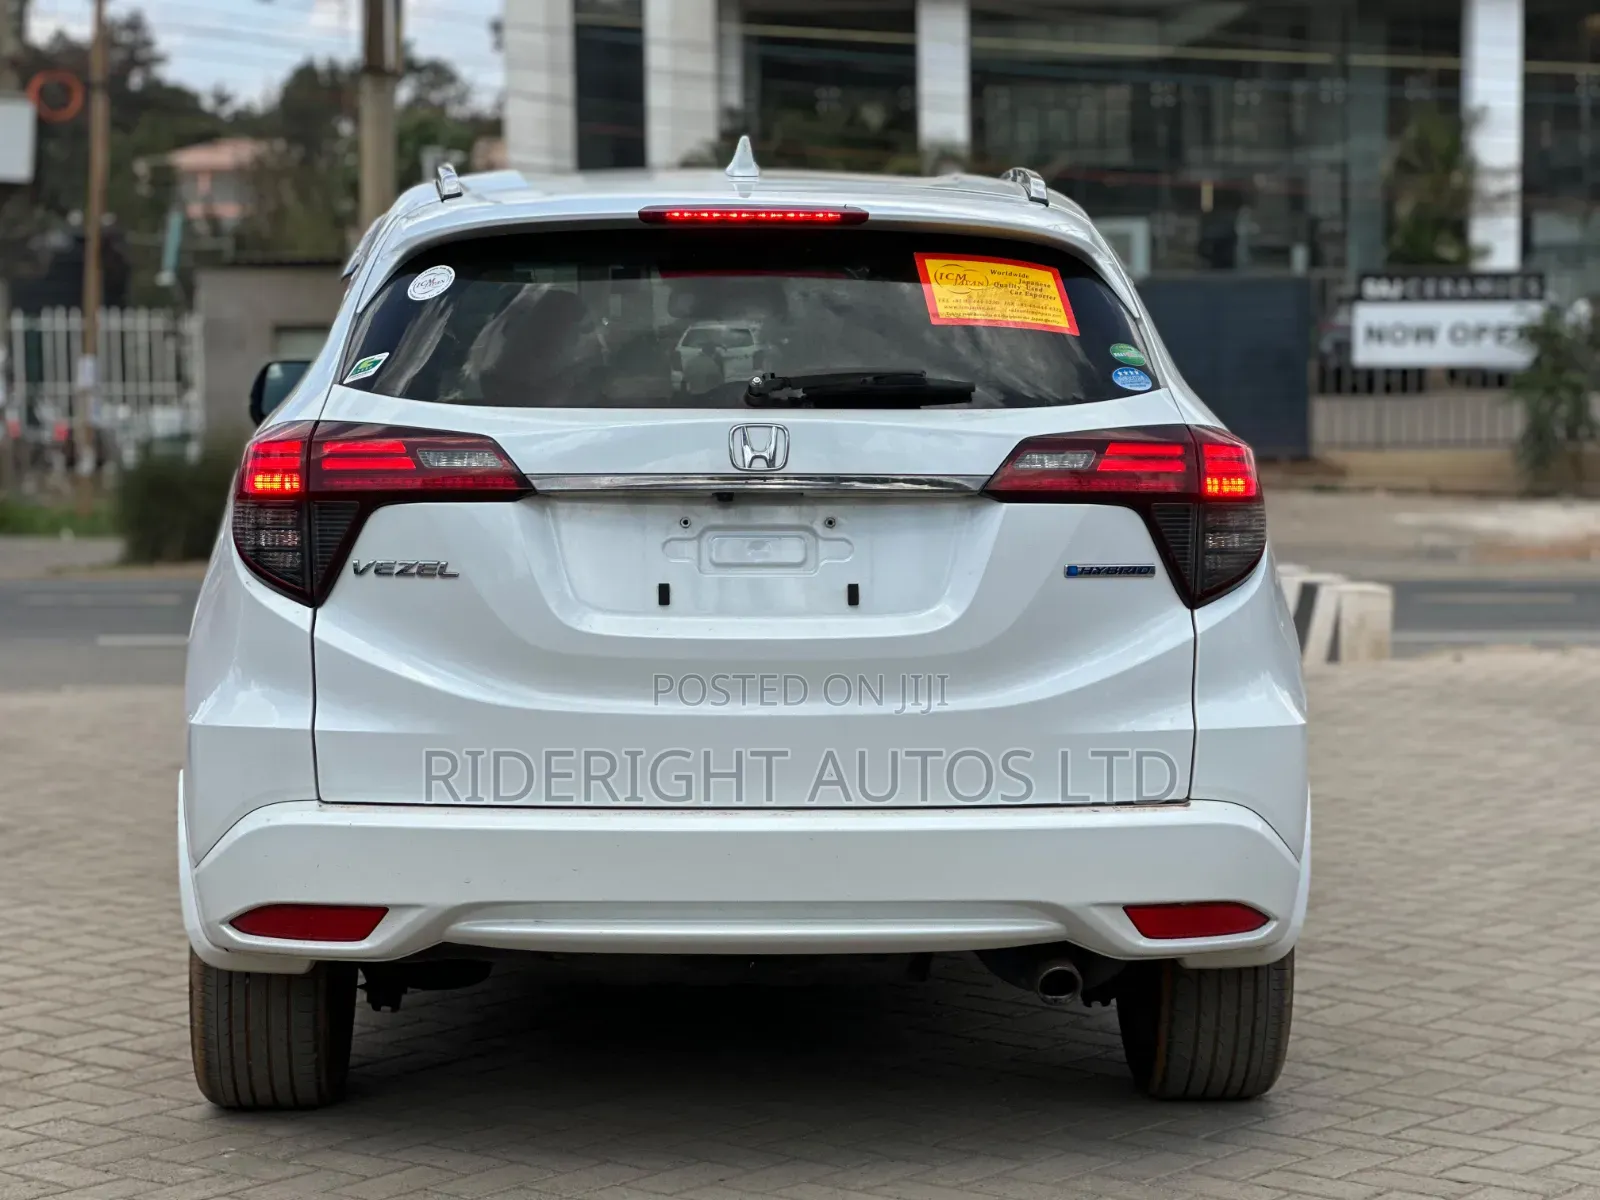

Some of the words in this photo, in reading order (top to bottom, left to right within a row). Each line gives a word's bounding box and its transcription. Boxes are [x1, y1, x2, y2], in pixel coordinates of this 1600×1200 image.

[939, 272, 967, 281] ICM
[990, 269, 1030, 279] Worldwide
[993, 281, 1021, 290] Quality
[1024, 291, 1056, 301] Exporter
[1363, 322, 1441, 347] NOW
[352, 559, 459, 577] VEZEL
